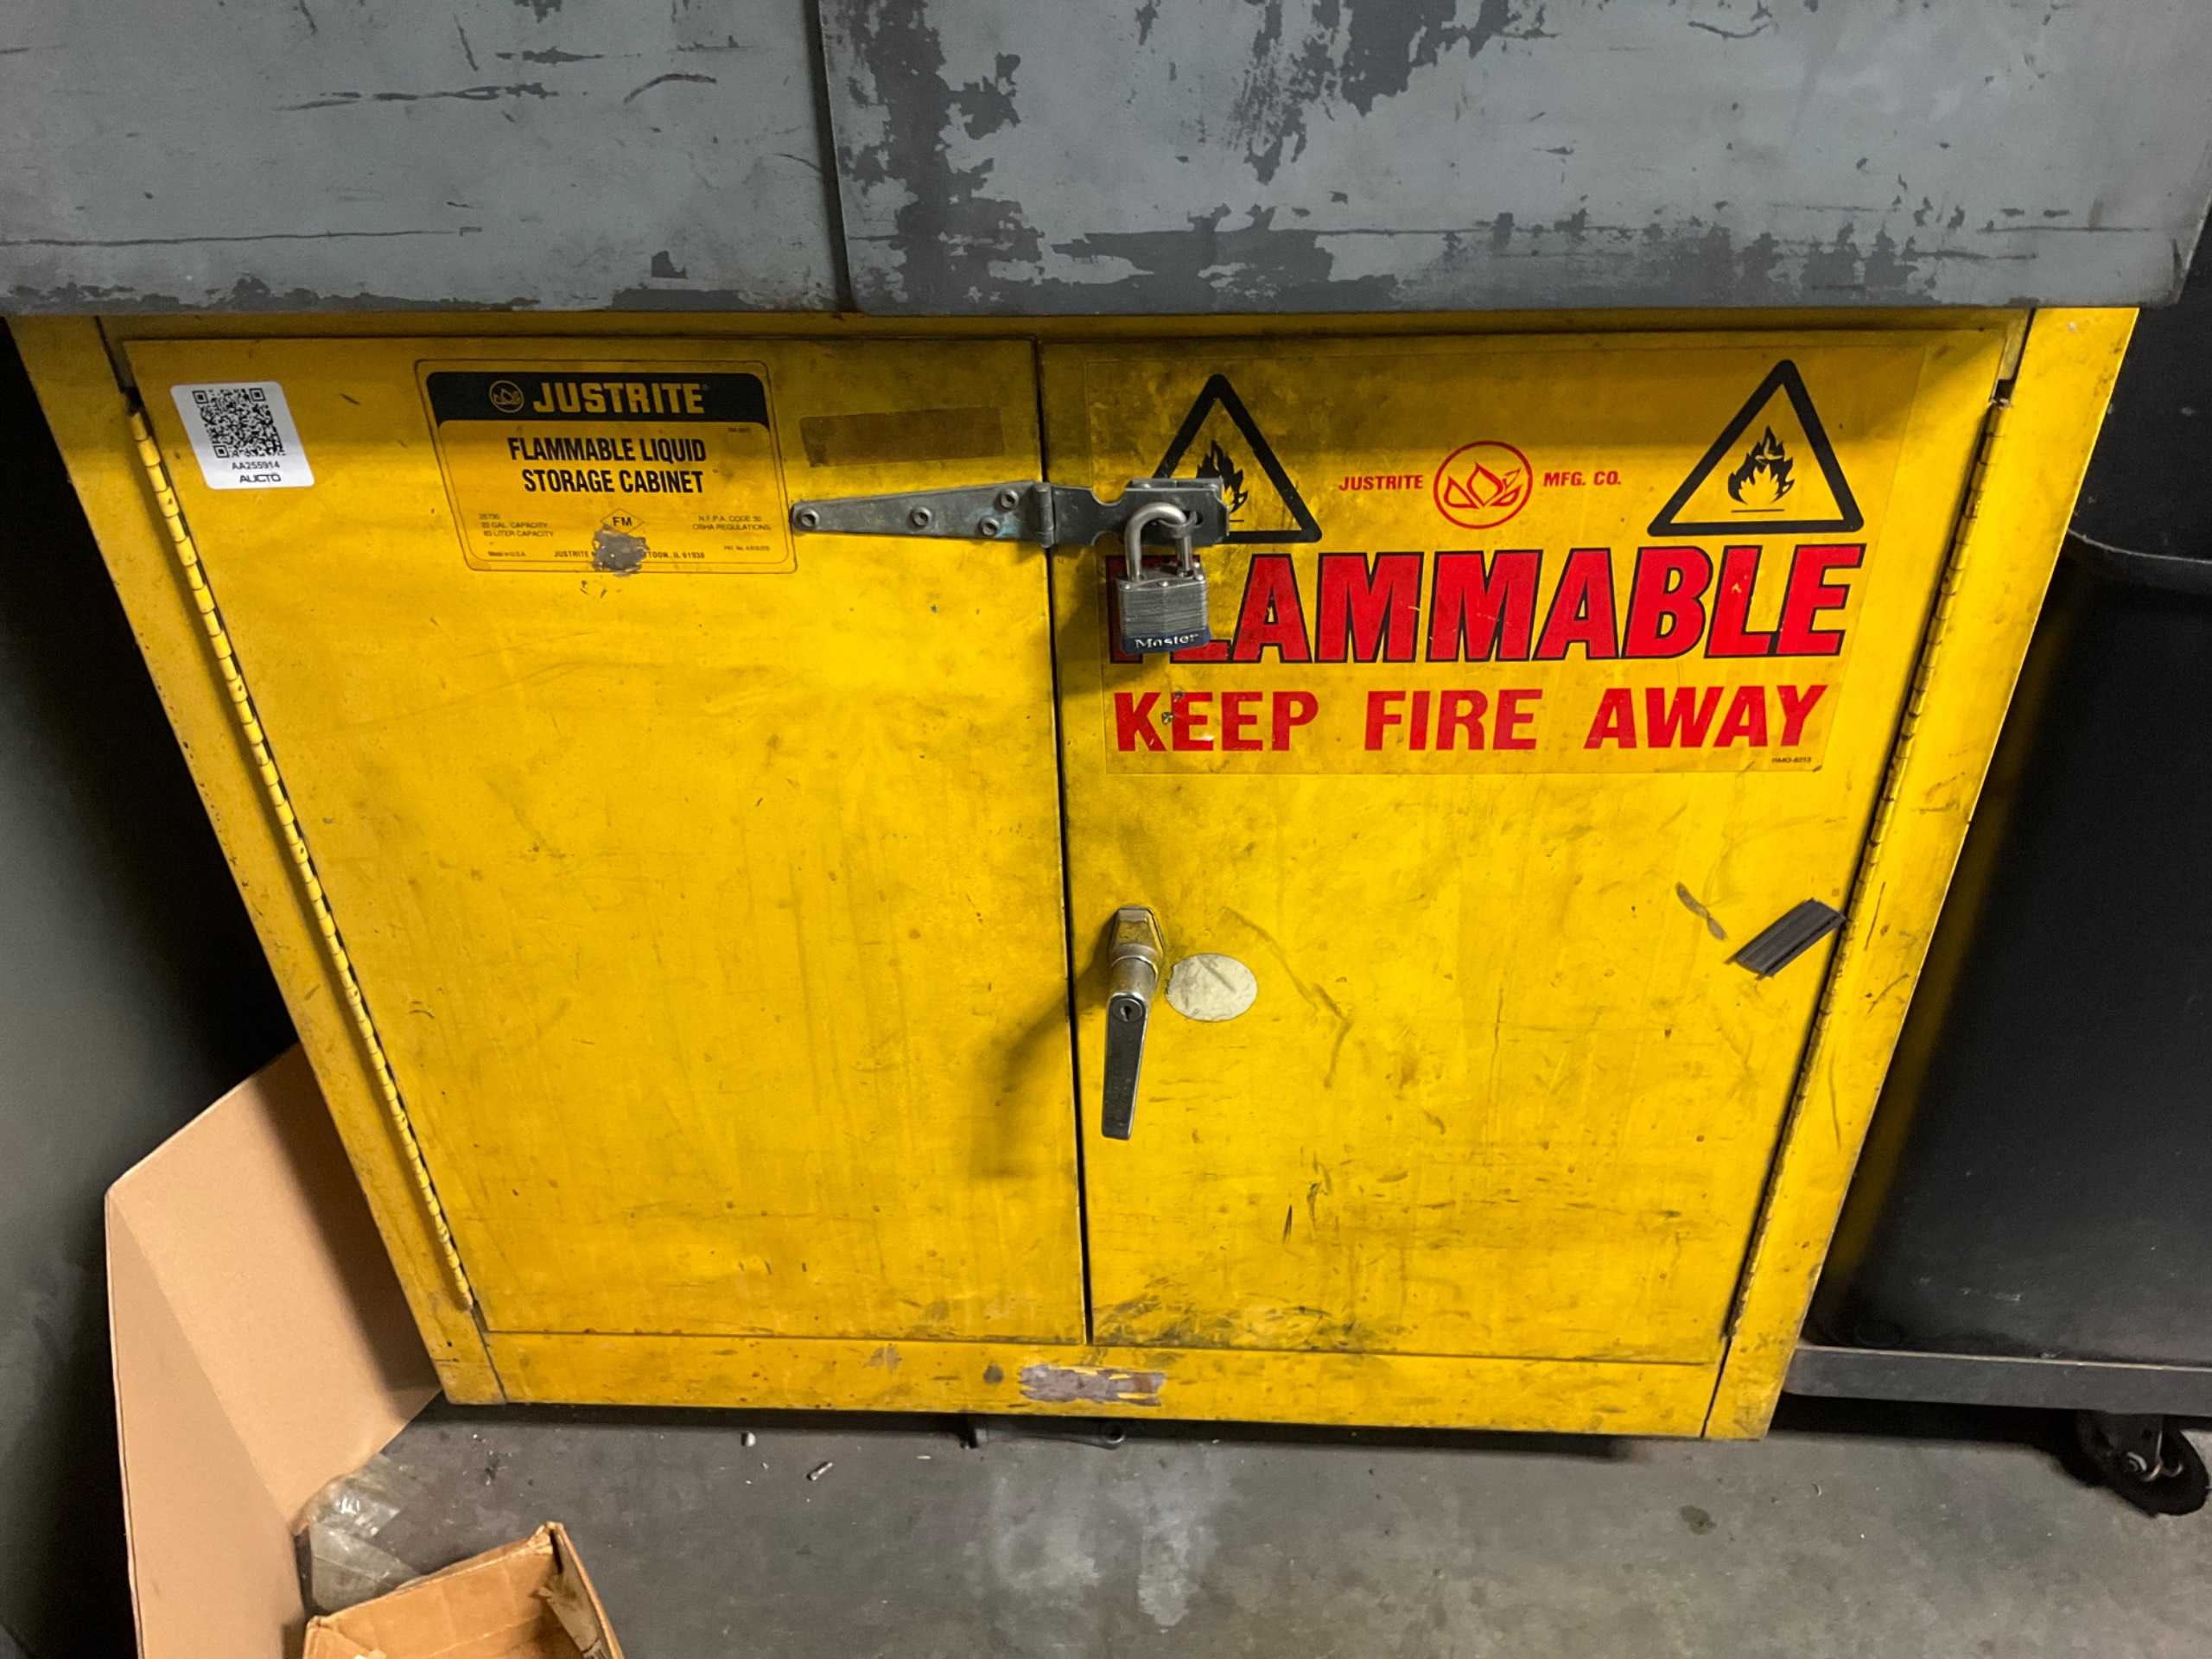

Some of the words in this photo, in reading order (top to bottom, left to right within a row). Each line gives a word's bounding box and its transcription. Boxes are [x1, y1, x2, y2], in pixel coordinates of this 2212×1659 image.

[532, 382, 706, 414] JUSTRITE
[507, 436, 636, 461] FLAMMABLE
[639, 437, 707, 464] LIQUID
[232, 460, 280, 470] AA255914
[239, 474, 282, 483] AUCTO
[522, 469, 615, 493] STORAGE
[620, 469, 704, 493] CABINET
[1339, 474, 1424, 491] JUSTRITE
[1542, 472, 1586, 487] MFG.
[1592, 471, 1622, 486] CO.
[613, 517, 632, 526] FM
[1106, 543, 1866, 664] AMMABLE
[1135, 632, 1199, 649] Master
[1114, 691, 1319, 753] KEEP
[1363, 689, 1543, 752] FIRE
[1585, 683, 1828, 750] AWAY
